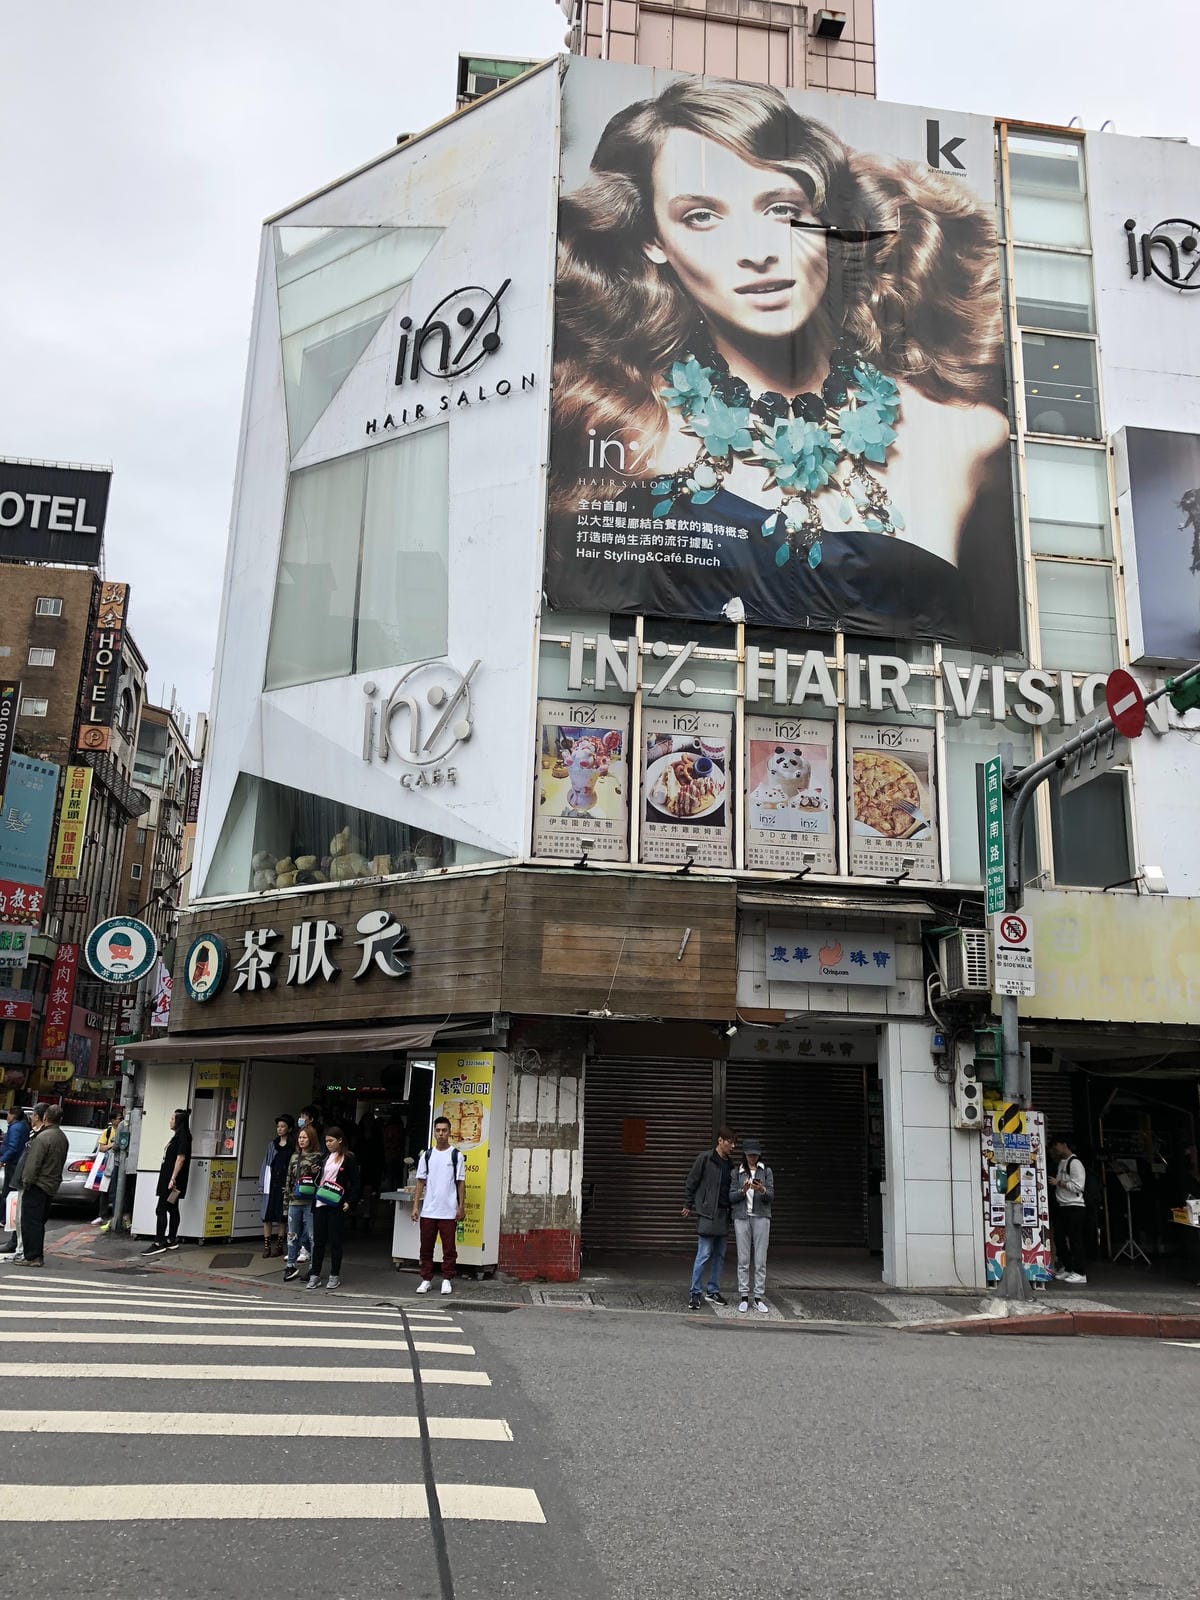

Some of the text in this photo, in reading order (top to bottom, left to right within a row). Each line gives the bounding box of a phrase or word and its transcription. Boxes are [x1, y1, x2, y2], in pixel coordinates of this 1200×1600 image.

[366, 373, 535, 434] HAIR SALON
[0, 491, 97, 534] OTEL
[578, 478, 671, 490] HAIR SALON
[576, 549, 721, 567] Hair Styling&Café.Bruch
[90, 633, 114, 722] HOTEL
[744, 645, 914, 714] HAIR
[988, 773, 1000, 862] 西寧南路
[66, 895, 87, 904] U2
[232, 910, 408, 993] 茶狀元
[50, 945, 75, 1025] 燒肉教室
